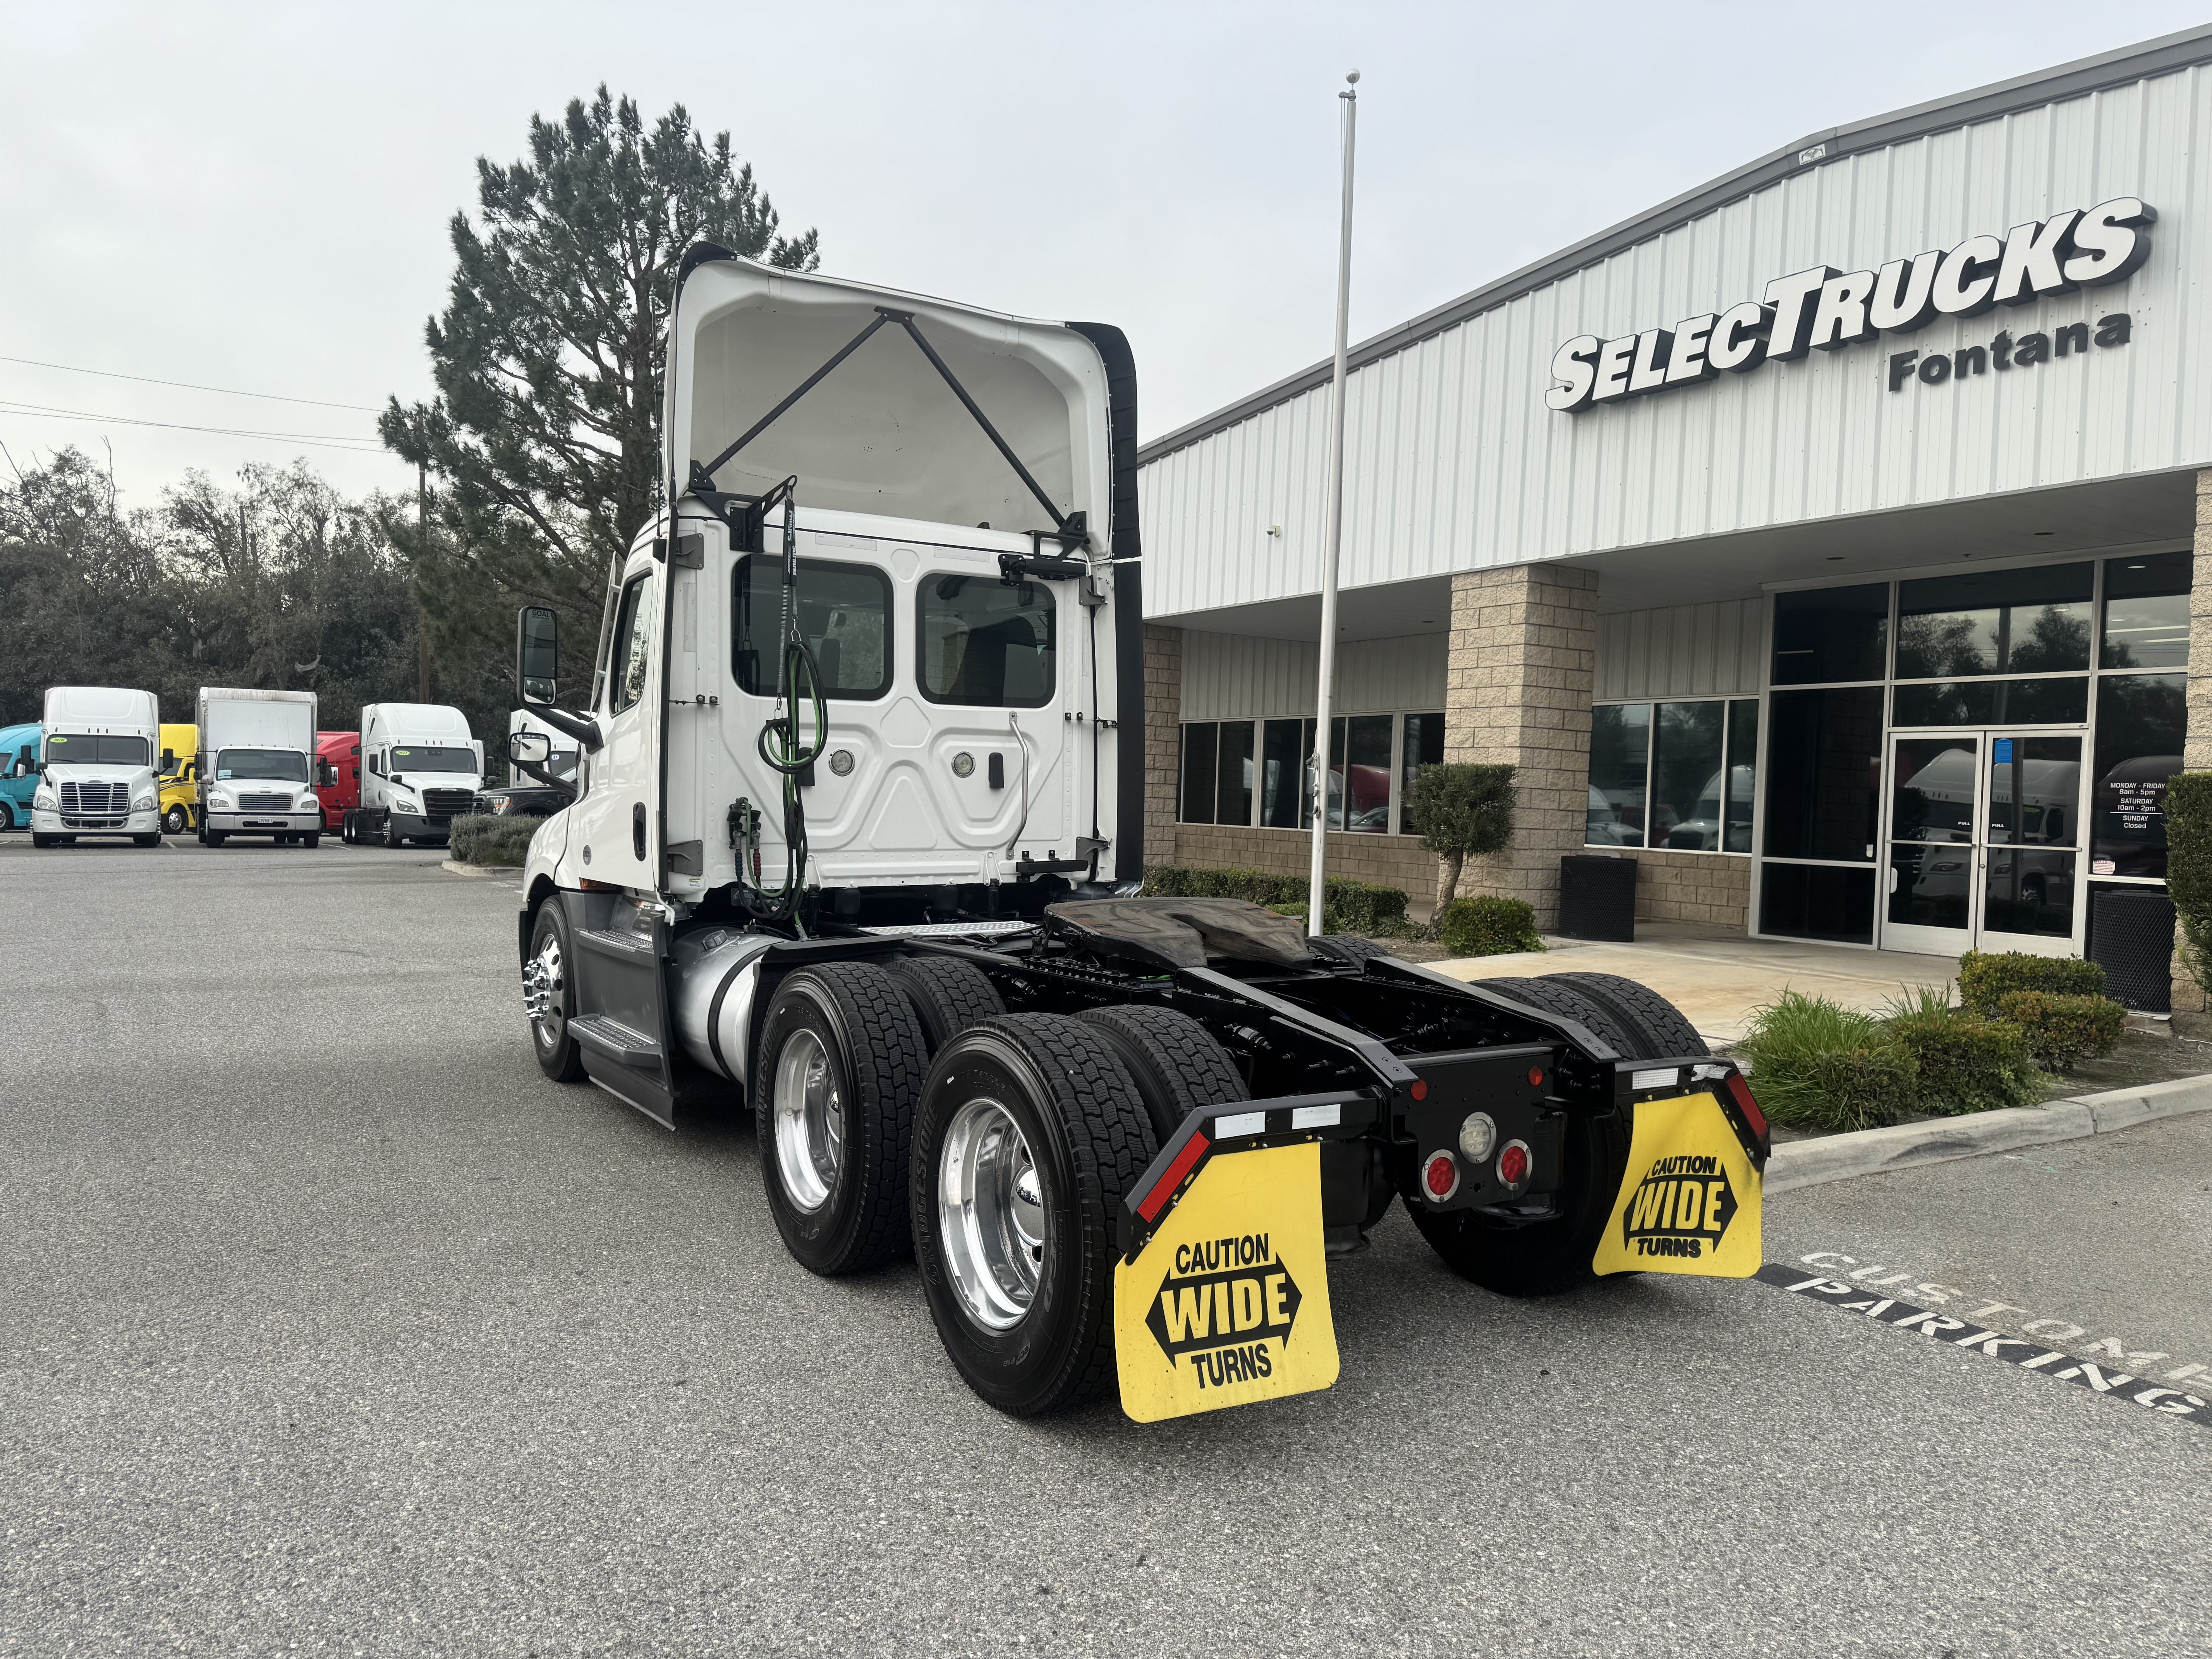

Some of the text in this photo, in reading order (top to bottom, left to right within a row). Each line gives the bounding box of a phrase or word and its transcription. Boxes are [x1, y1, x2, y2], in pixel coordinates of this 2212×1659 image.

[1544, 196, 2153, 412] SELECTRUCKS
[1888, 313, 2131, 392] Fontana
[915, 1099, 941, 1285] BRIDGESTONE
[1651, 1156, 1717, 1175] CAUTION
[1629, 1180, 1725, 1232] WIDE
[1175, 1233, 1269, 1275] CAUTION
[1637, 1238, 1701, 1258] TURNS
[1160, 1273, 1290, 1344] WIDE
[1191, 1343, 1272, 1389] TURNS
[1784, 1277, 2209, 1414] PARKING
